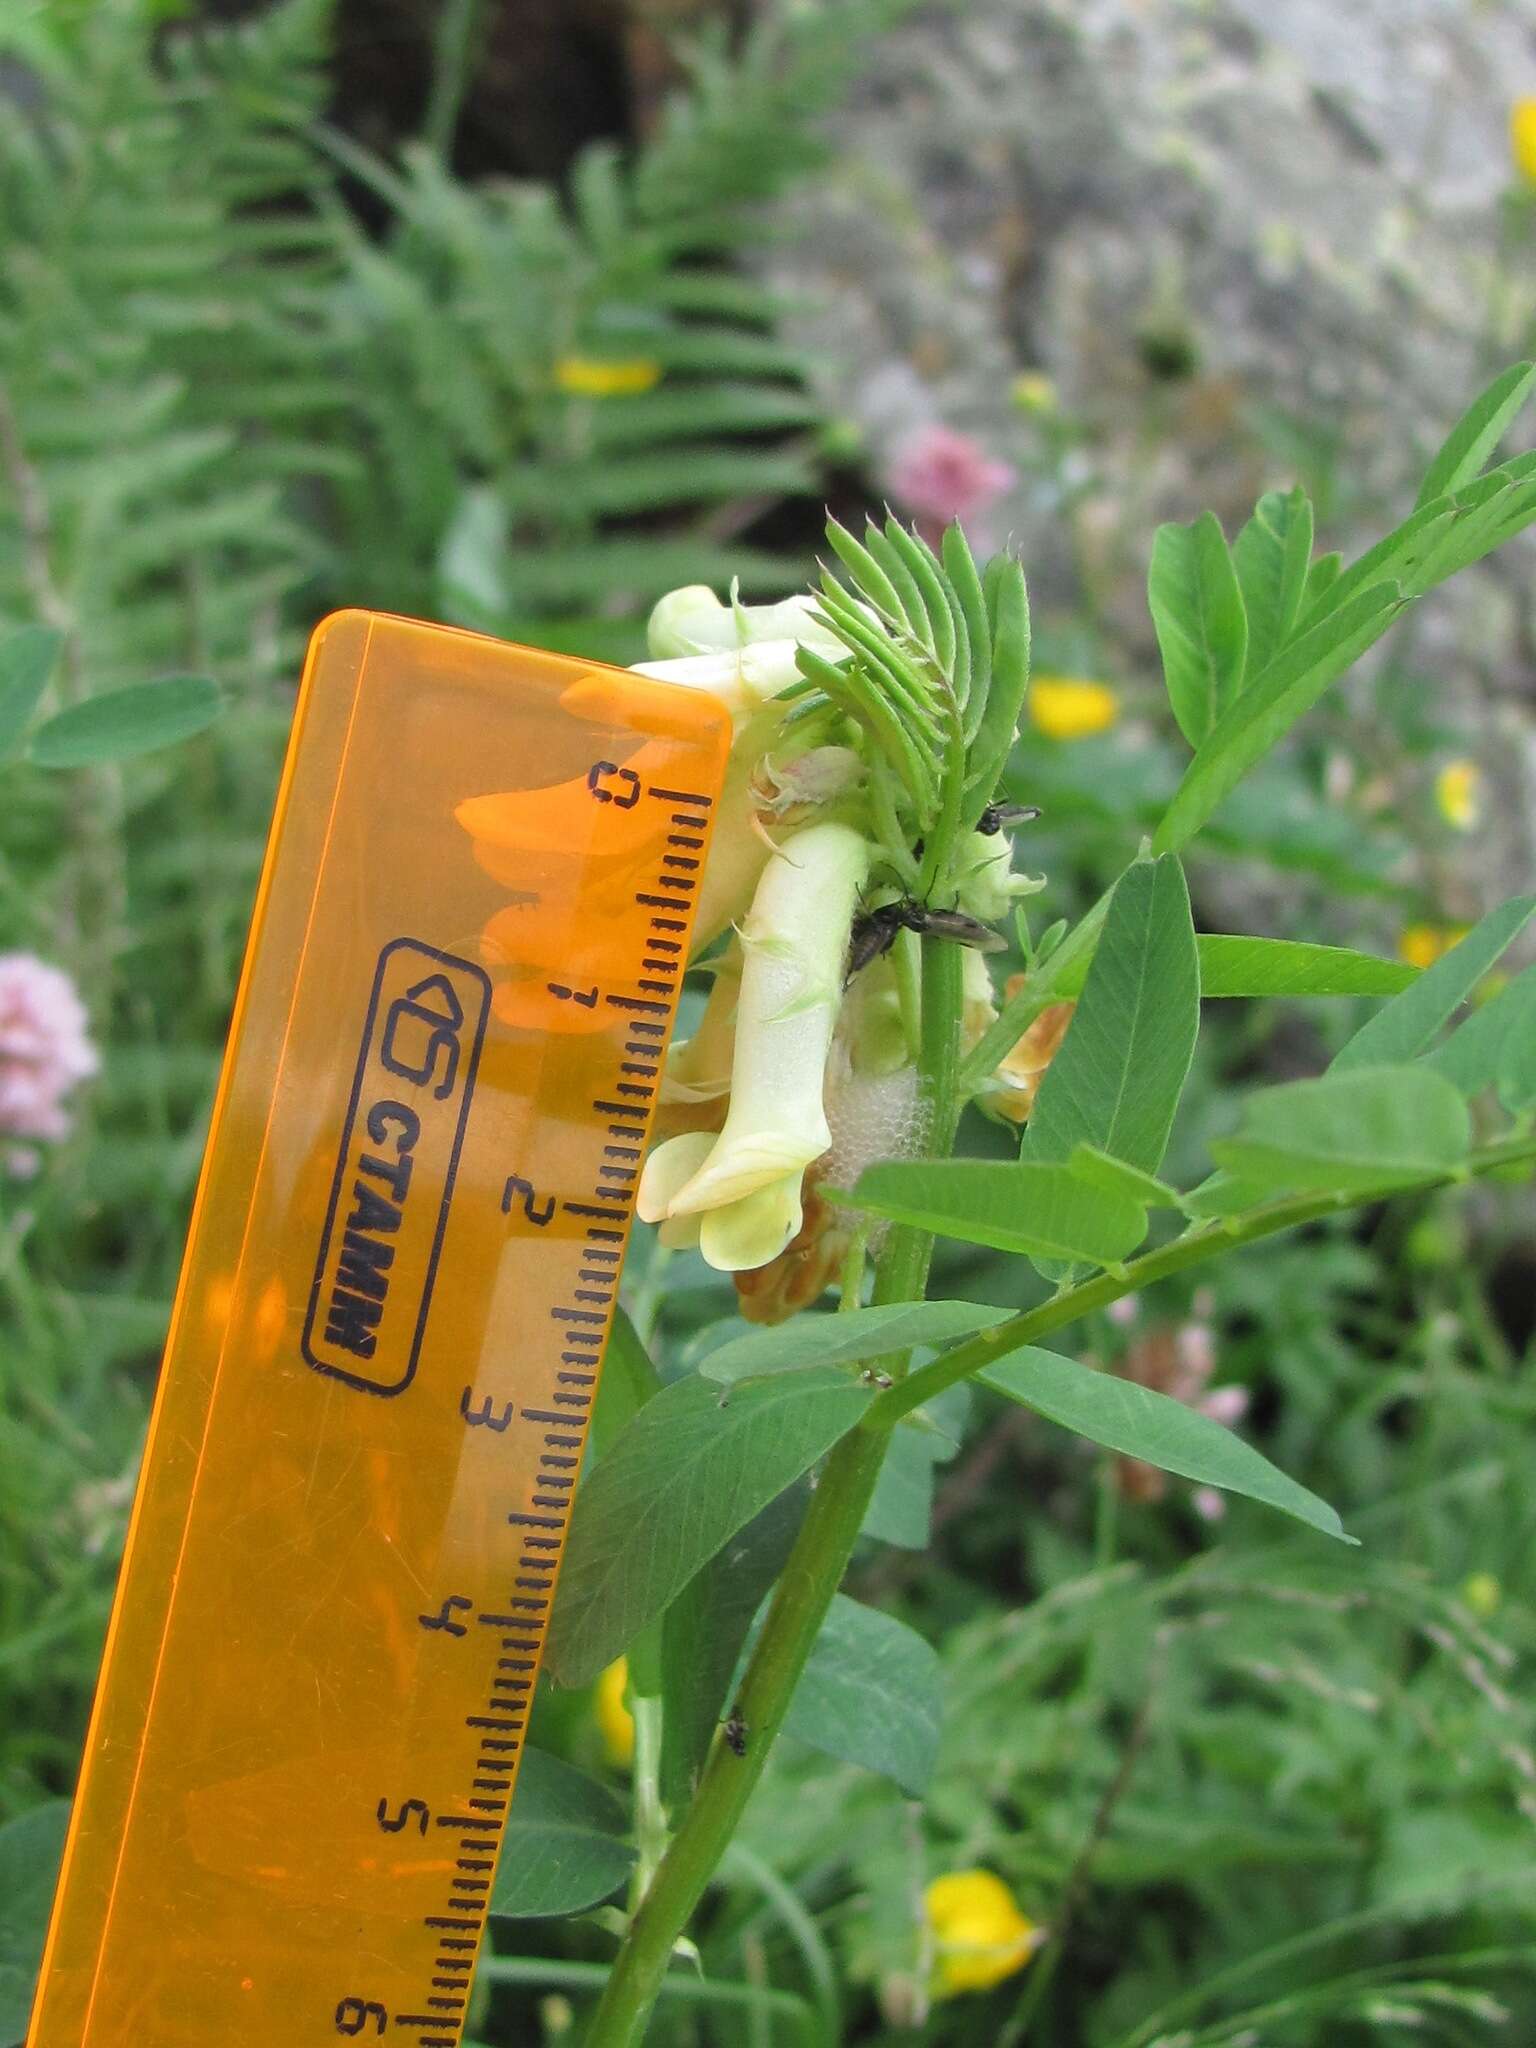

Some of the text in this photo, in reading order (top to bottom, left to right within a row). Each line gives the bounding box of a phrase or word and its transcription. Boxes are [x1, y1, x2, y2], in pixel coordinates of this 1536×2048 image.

[334, 760, 641, 2037] 0 1 2 3 4 5 6
